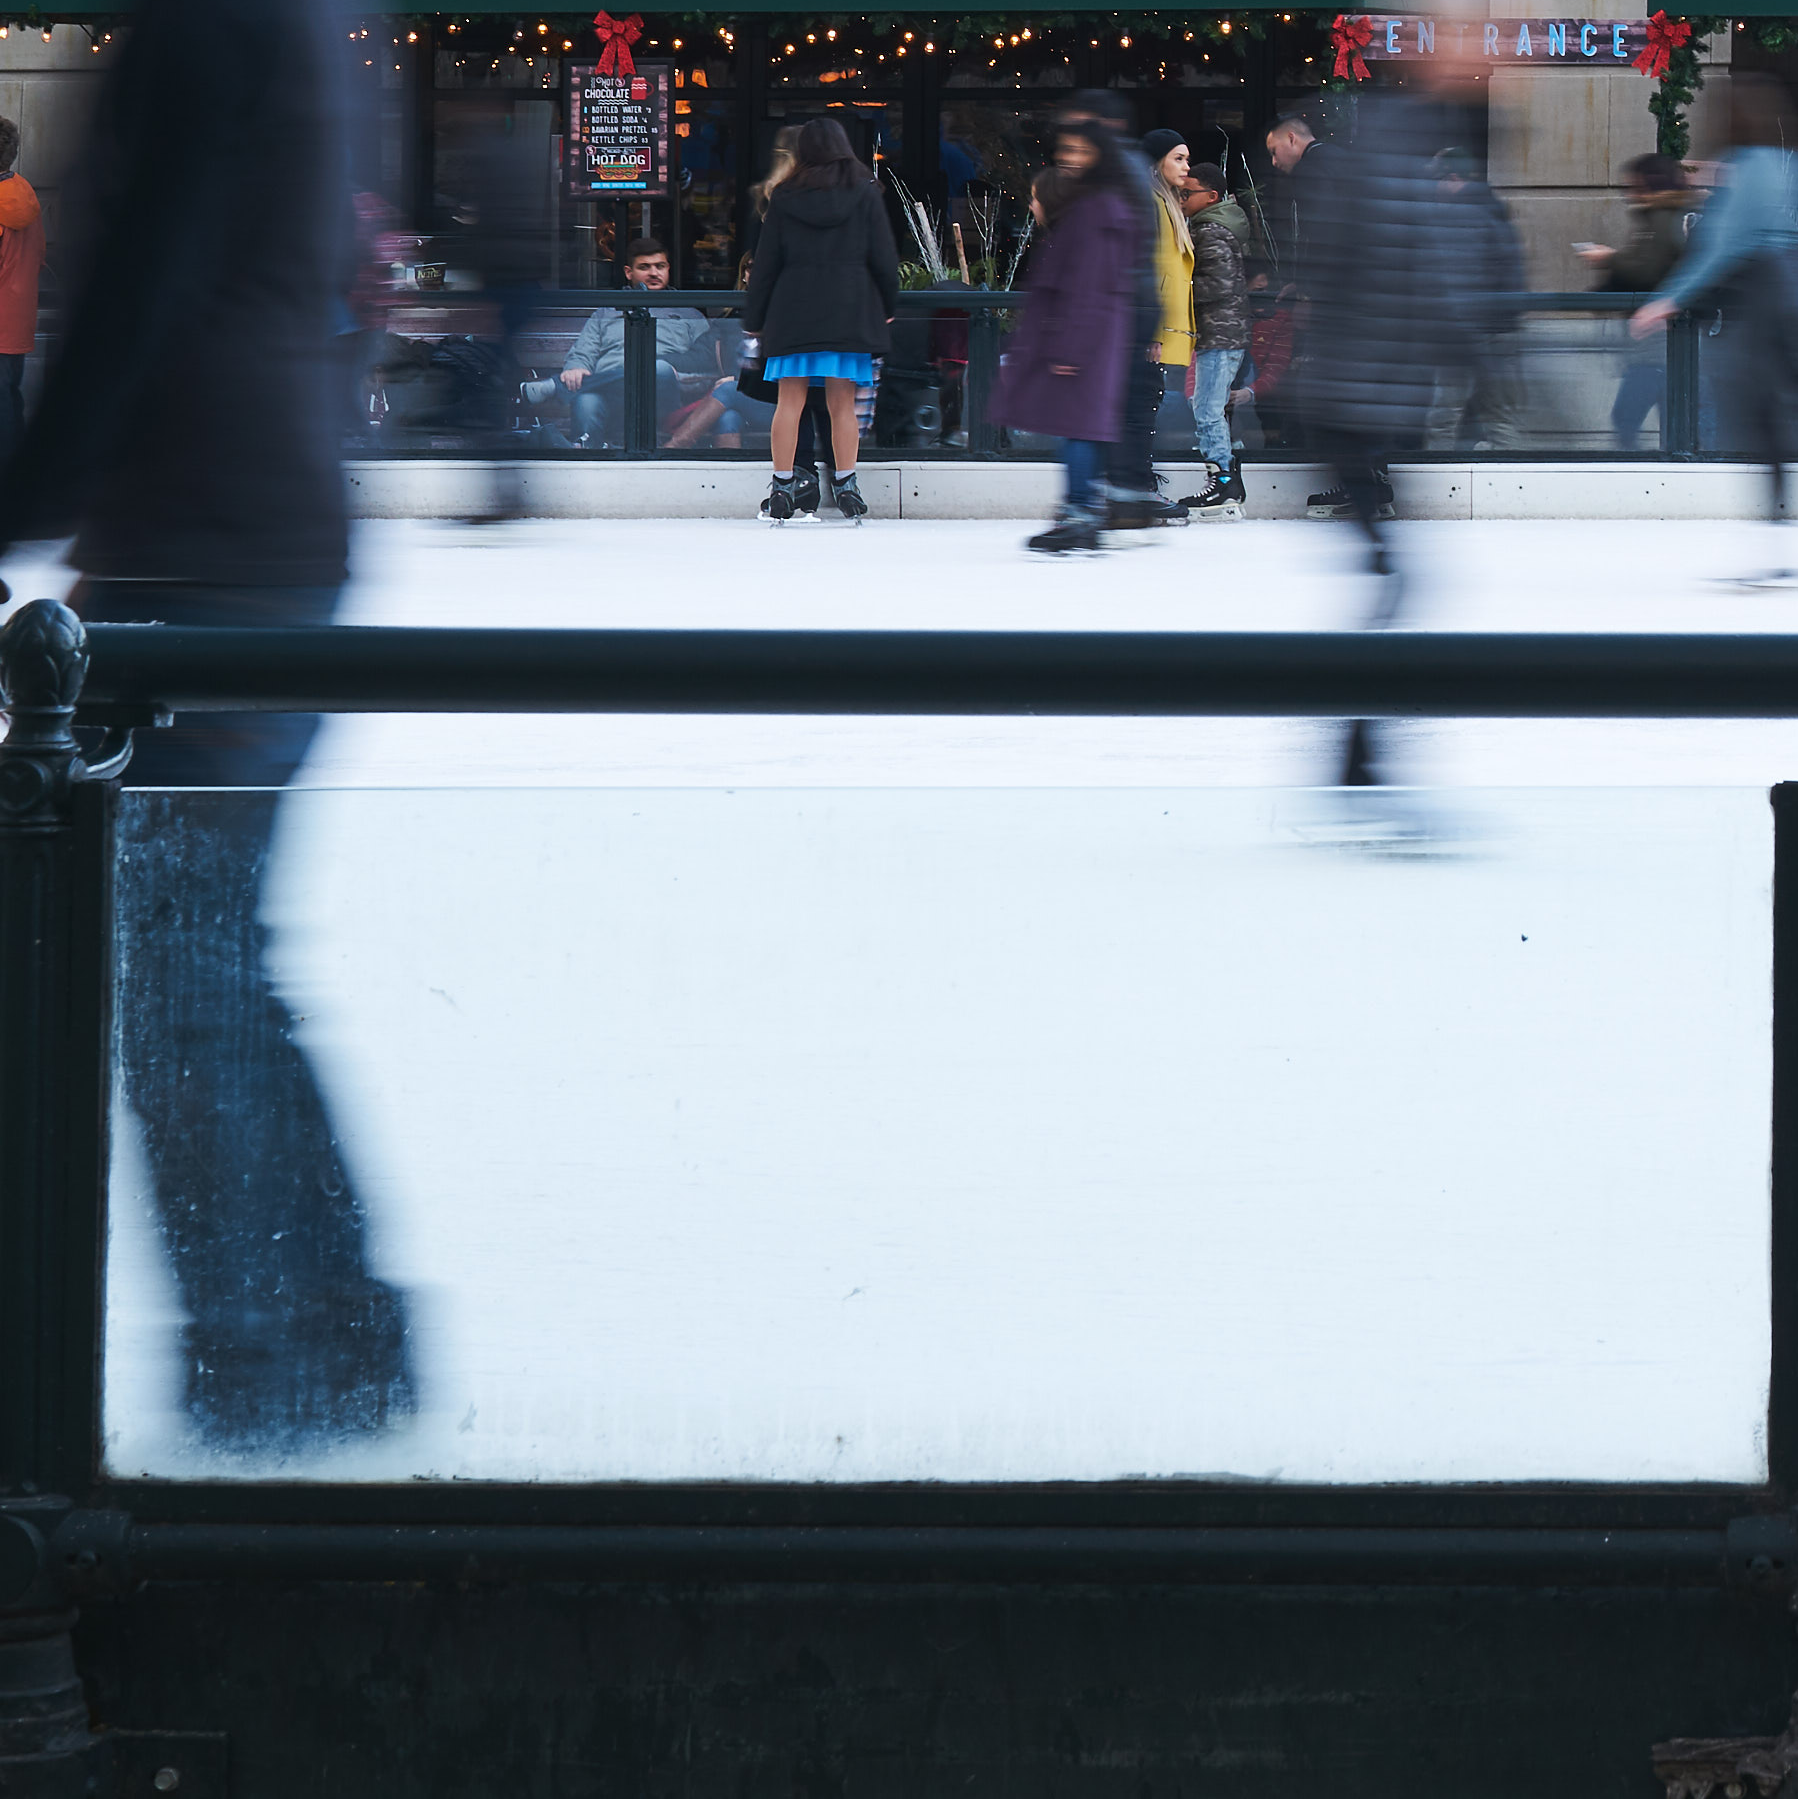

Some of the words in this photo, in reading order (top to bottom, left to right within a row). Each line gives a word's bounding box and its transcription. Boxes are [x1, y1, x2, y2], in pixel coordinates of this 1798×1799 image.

[584, 88, 630, 99] CHOCOLATE
[591, 105, 619, 114] BOTTLED
[622, 105, 642, 114] WATER
[591, 115, 619, 124] BOTTLED
[622, 115, 638, 124] SODA
[621, 125, 648, 134] PRETZEL
[591, 135, 615, 144] KETTLE
[618, 135, 638, 144] CHIPS
[591, 154, 616, 165] HOT
[620, 154, 646, 165] DOG
